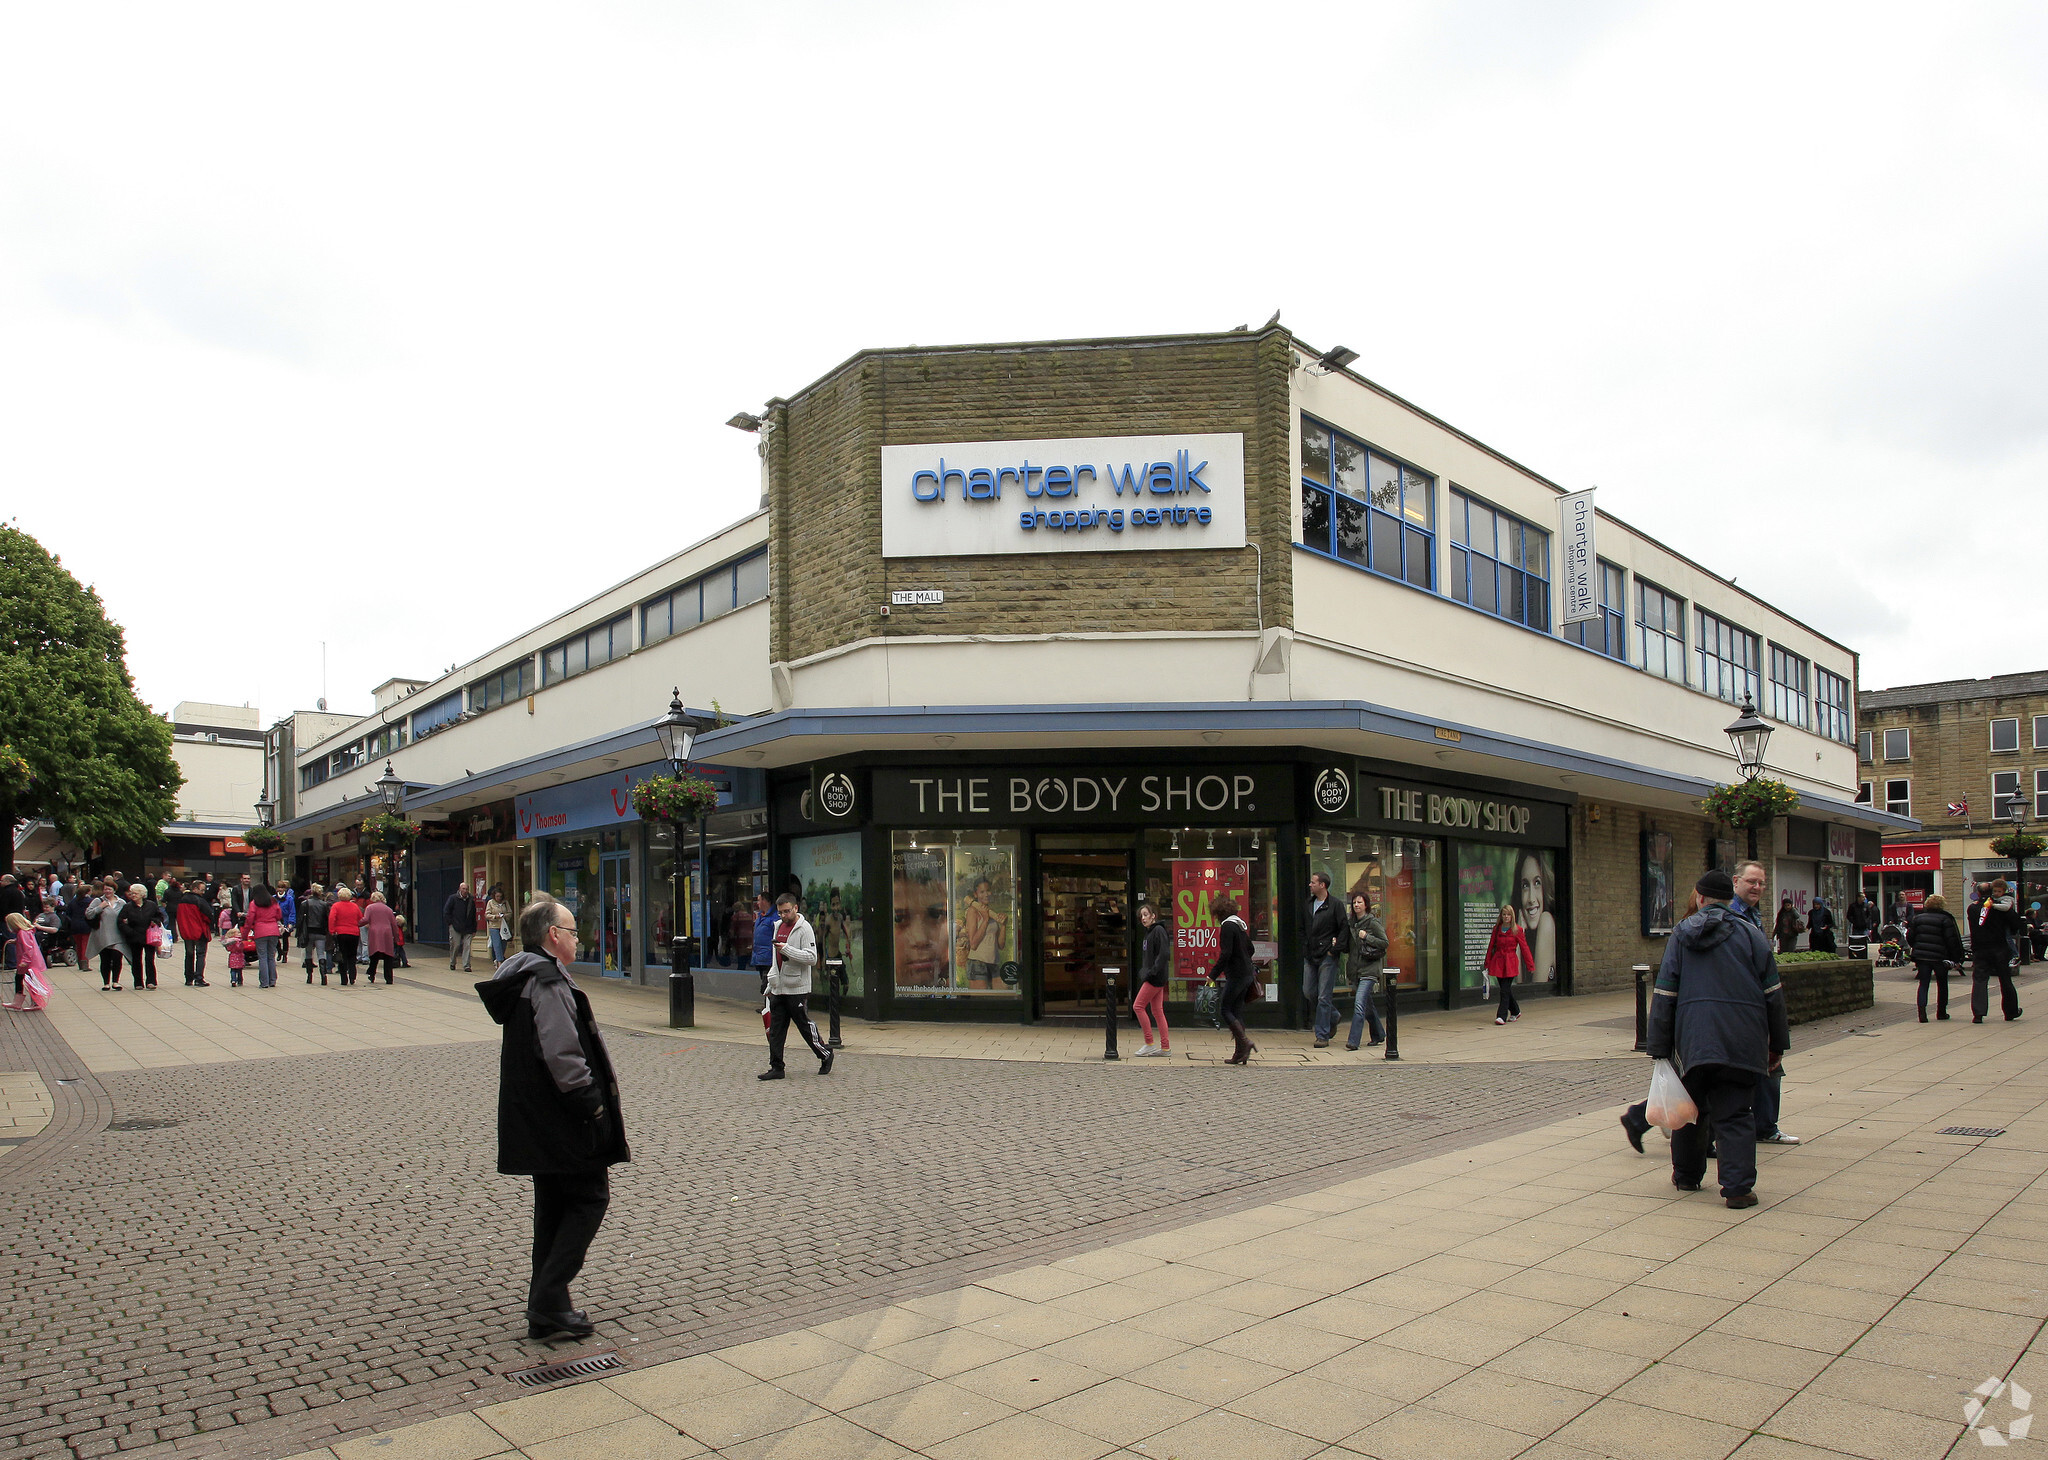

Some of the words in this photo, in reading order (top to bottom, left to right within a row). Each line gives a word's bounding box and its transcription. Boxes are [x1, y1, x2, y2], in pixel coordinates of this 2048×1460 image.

[912, 457, 1097, 502] charter
[1106, 449, 1212, 497] walk
[1019, 504, 1125, 533] shopping
[1130, 504, 1212, 526] centre
[1575, 501, 1588, 567] charter
[1568, 545, 1576, 584] shopping
[892, 593, 912, 603] THE
[916, 592, 942, 602] MALL
[1569, 586, 1577, 613] centre
[1577, 572, 1592, 612] walk
[1321, 788, 1343, 797] BODY
[1325, 781, 1338, 789] THE
[827, 793, 848, 801] BODY
[910, 778, 990, 813] THE
[1009, 777, 1127, 813] BODY
[1322, 796, 1343, 804] SHOP
[1378, 786, 1423, 823] THE
[1427, 794, 1482, 829] BODY
[1483, 801, 1530, 834] SHOP
[535, 812, 567, 829] Thomson
[1830, 830, 1854, 858] GAME
[1864, 852, 1931, 867] tander
[1986, 861, 2030, 869] BUILDIG
[1178, 929, 1187, 938] TO
[1188, 928, 1217, 948] 50%
[1178, 938, 1187, 948] UP
